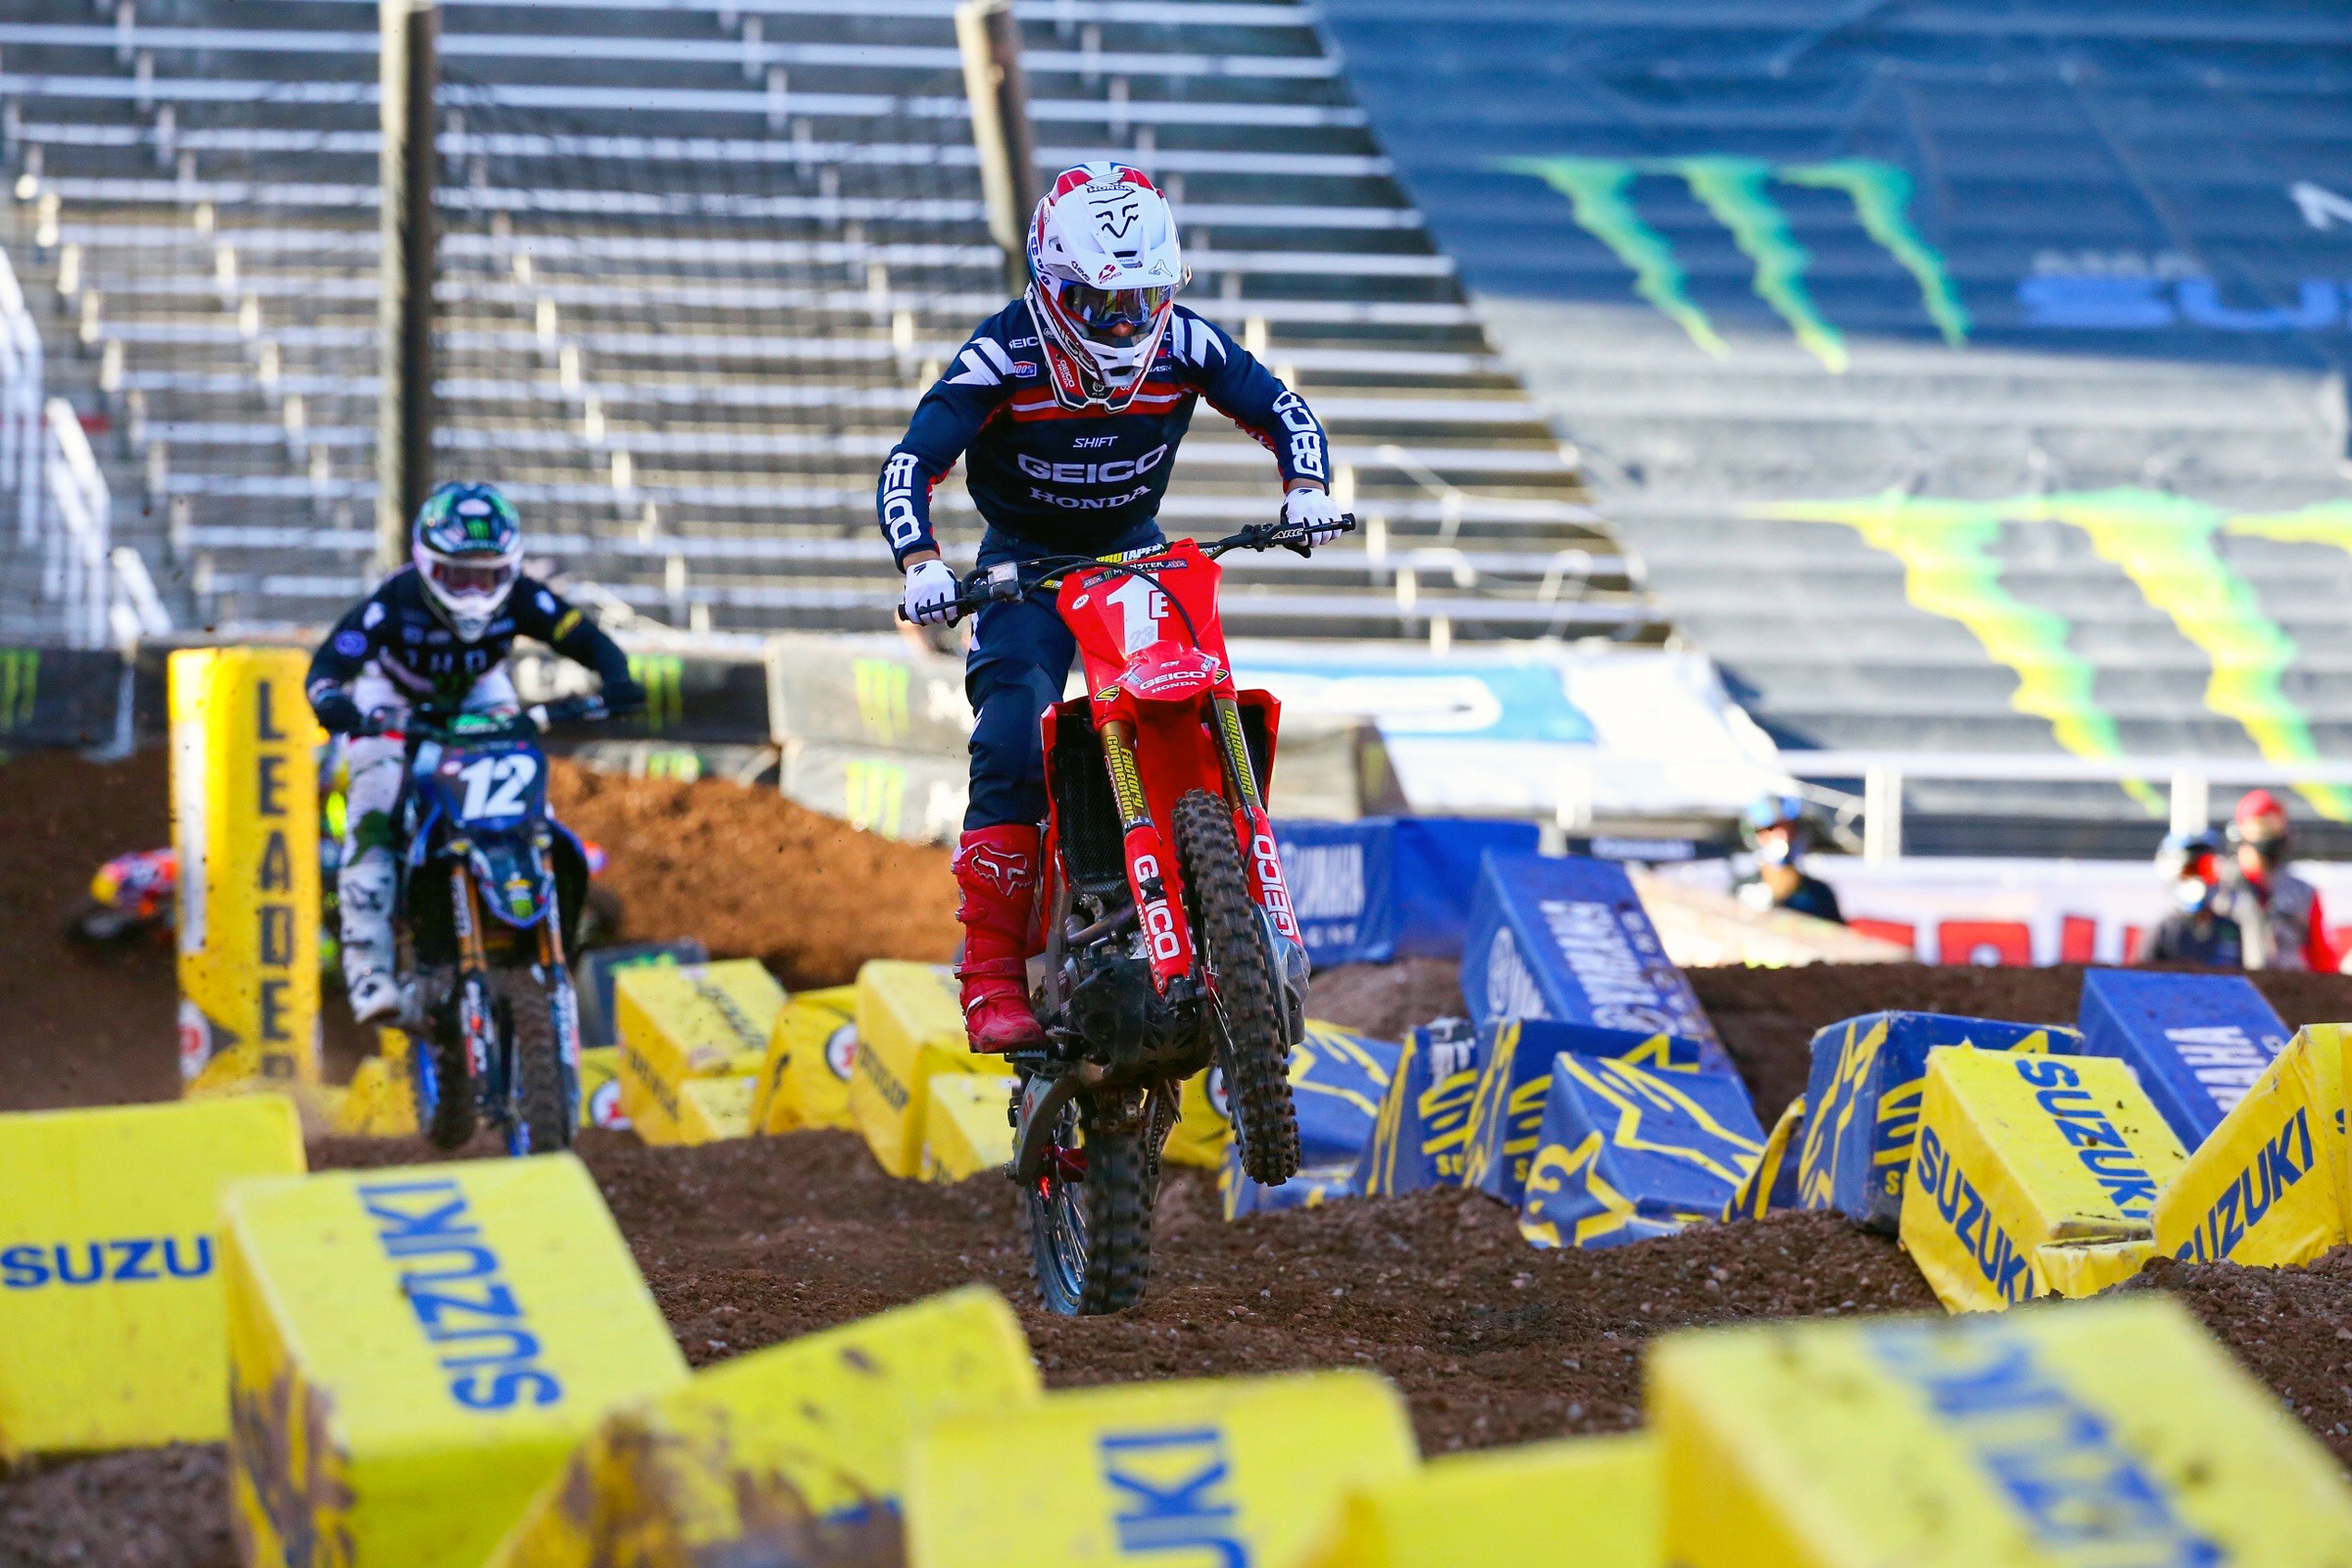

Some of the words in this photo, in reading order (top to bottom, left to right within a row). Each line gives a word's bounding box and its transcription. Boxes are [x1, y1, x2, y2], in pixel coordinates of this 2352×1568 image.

[1089, 184, 1132, 194] HONDA
[1008, 336, 1040, 350] EIC
[1072, 435, 1118, 448] SHIFT
[1017, 444, 1167, 484] GEICO
[1029, 485, 1152, 510] HONDA
[1139, 670, 1206, 690] GEICO
[1151, 680, 1200, 694] HONDA
[458, 754, 538, 821] 12
[1253, 834, 1296, 937] GEICO
[1133, 855, 1181, 961] GICO
[2015, 1059, 2158, 1218] SUZUKI
[1917, 1125, 2034, 1306] SUZUKI
[356, 1179, 563, 1411] SUZUKI
